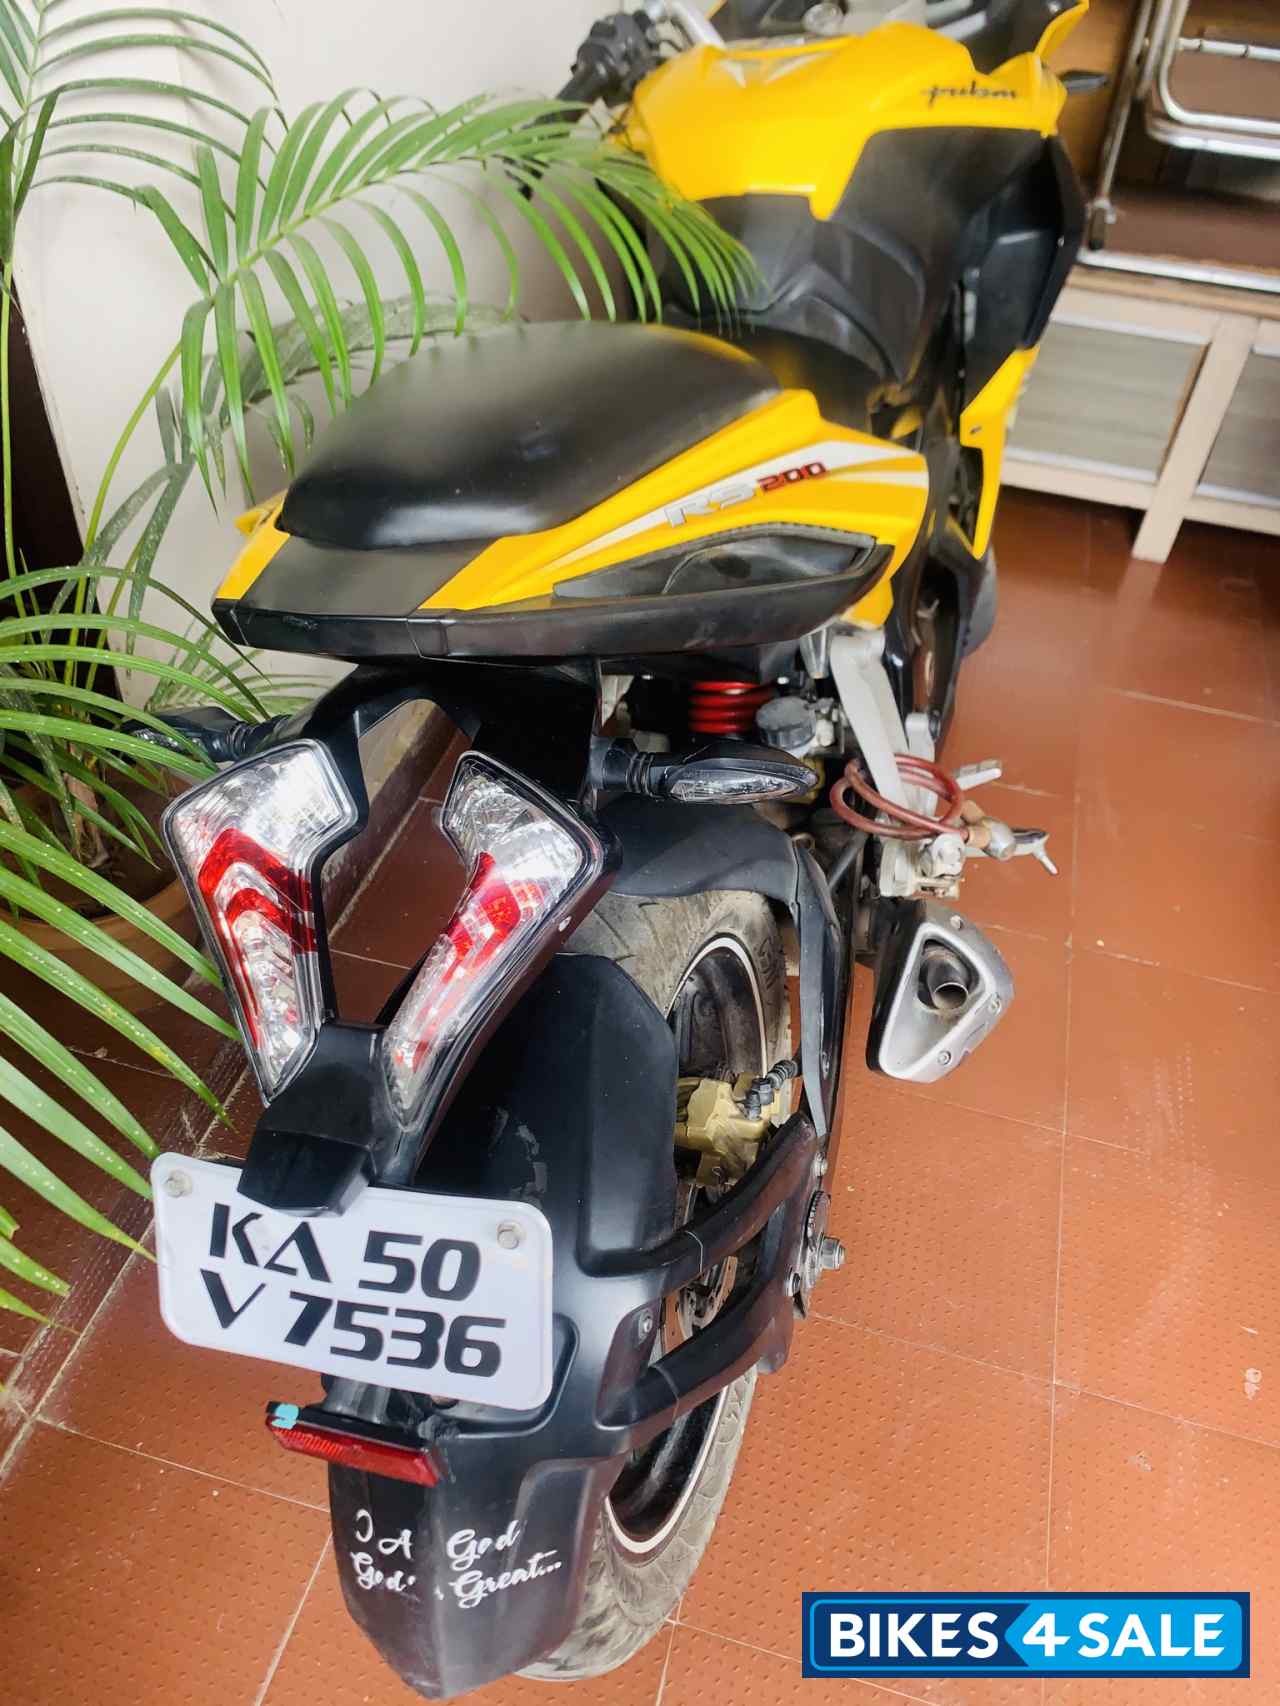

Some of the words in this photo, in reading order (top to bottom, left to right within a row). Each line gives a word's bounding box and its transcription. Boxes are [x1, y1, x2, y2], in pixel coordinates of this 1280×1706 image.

[209, 1203, 332, 1283] KA
[358, 1230, 481, 1301] 50
[200, 1268, 267, 1329] V
[284, 1290, 507, 1378] 7536
[446, 1519, 522, 1571] God
